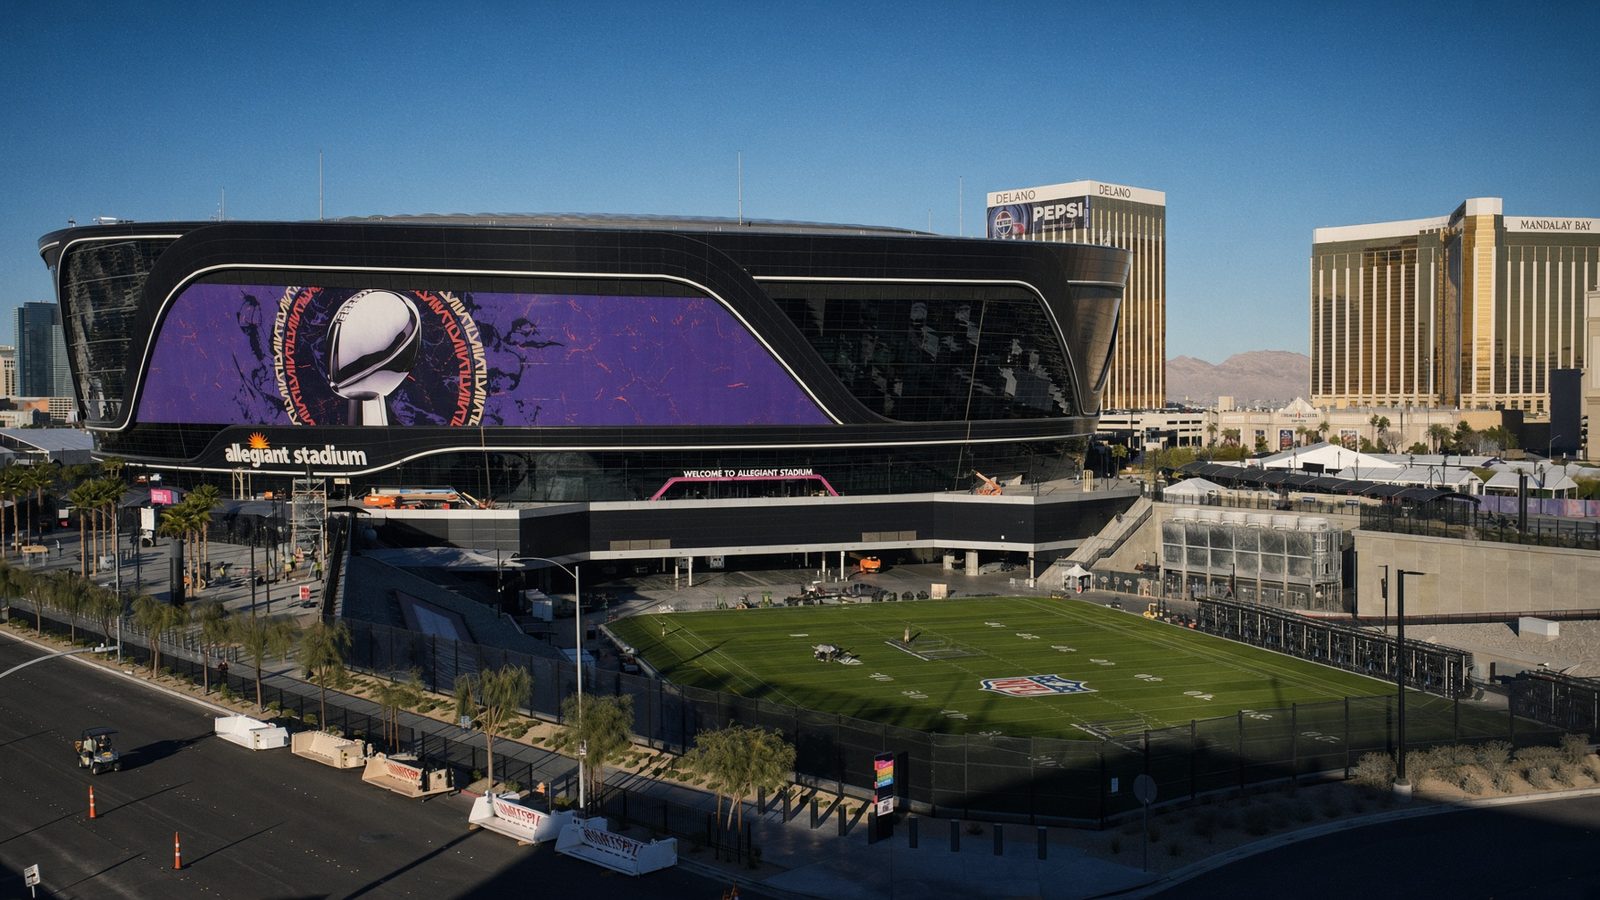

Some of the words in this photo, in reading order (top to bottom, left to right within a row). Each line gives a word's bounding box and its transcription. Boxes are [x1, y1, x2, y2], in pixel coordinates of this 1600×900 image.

[996, 190, 1036, 204] DELANO
[1099, 184, 1131, 198] DELANO
[1033, 202, 1083, 222] PEPSI
[1520, 220, 1572, 230] MANDALAY
[1575, 221, 1592, 230] BAY
[225, 443, 291, 468] allegiant
[294, 444, 368, 466] stadium
[683, 470, 722, 478] WELCOME
[724, 469, 735, 477] TO
[737, 468, 777, 477] ALLEGIANT
[780, 468, 813, 476] STADIUM
